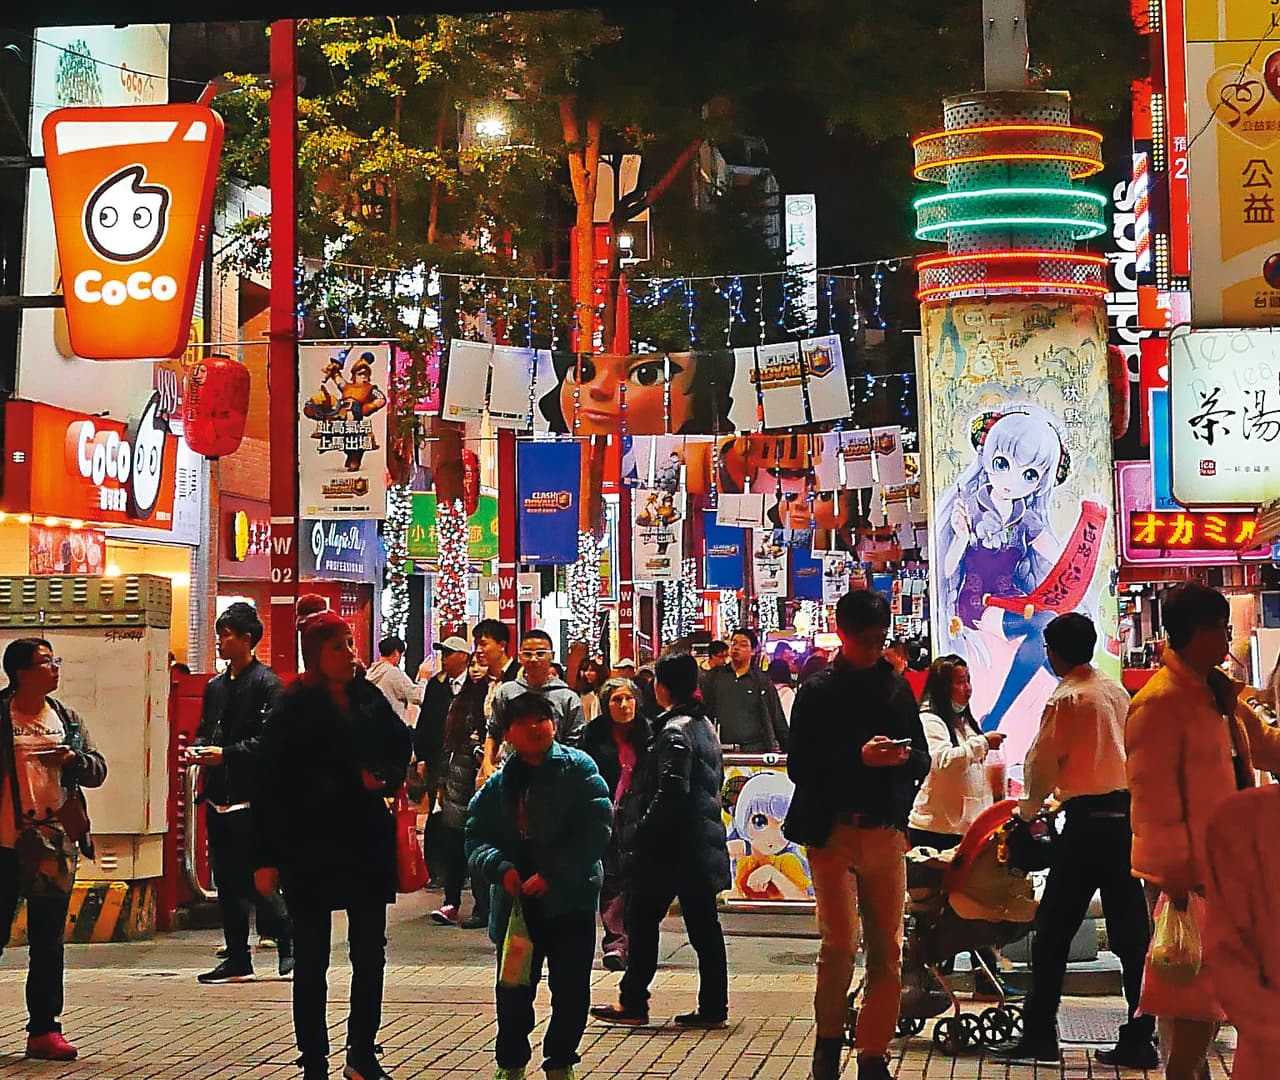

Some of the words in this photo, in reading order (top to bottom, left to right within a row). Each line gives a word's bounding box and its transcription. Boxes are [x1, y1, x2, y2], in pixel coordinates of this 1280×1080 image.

[74, 269, 177, 306] CoCo
[273, 537, 292, 555] W
[272, 568, 292, 583] 02
[500, 577, 514, 590] W
[621, 591, 631, 601] W
[500, 598, 514, 610] 04
[620, 608, 632, 617] 06
